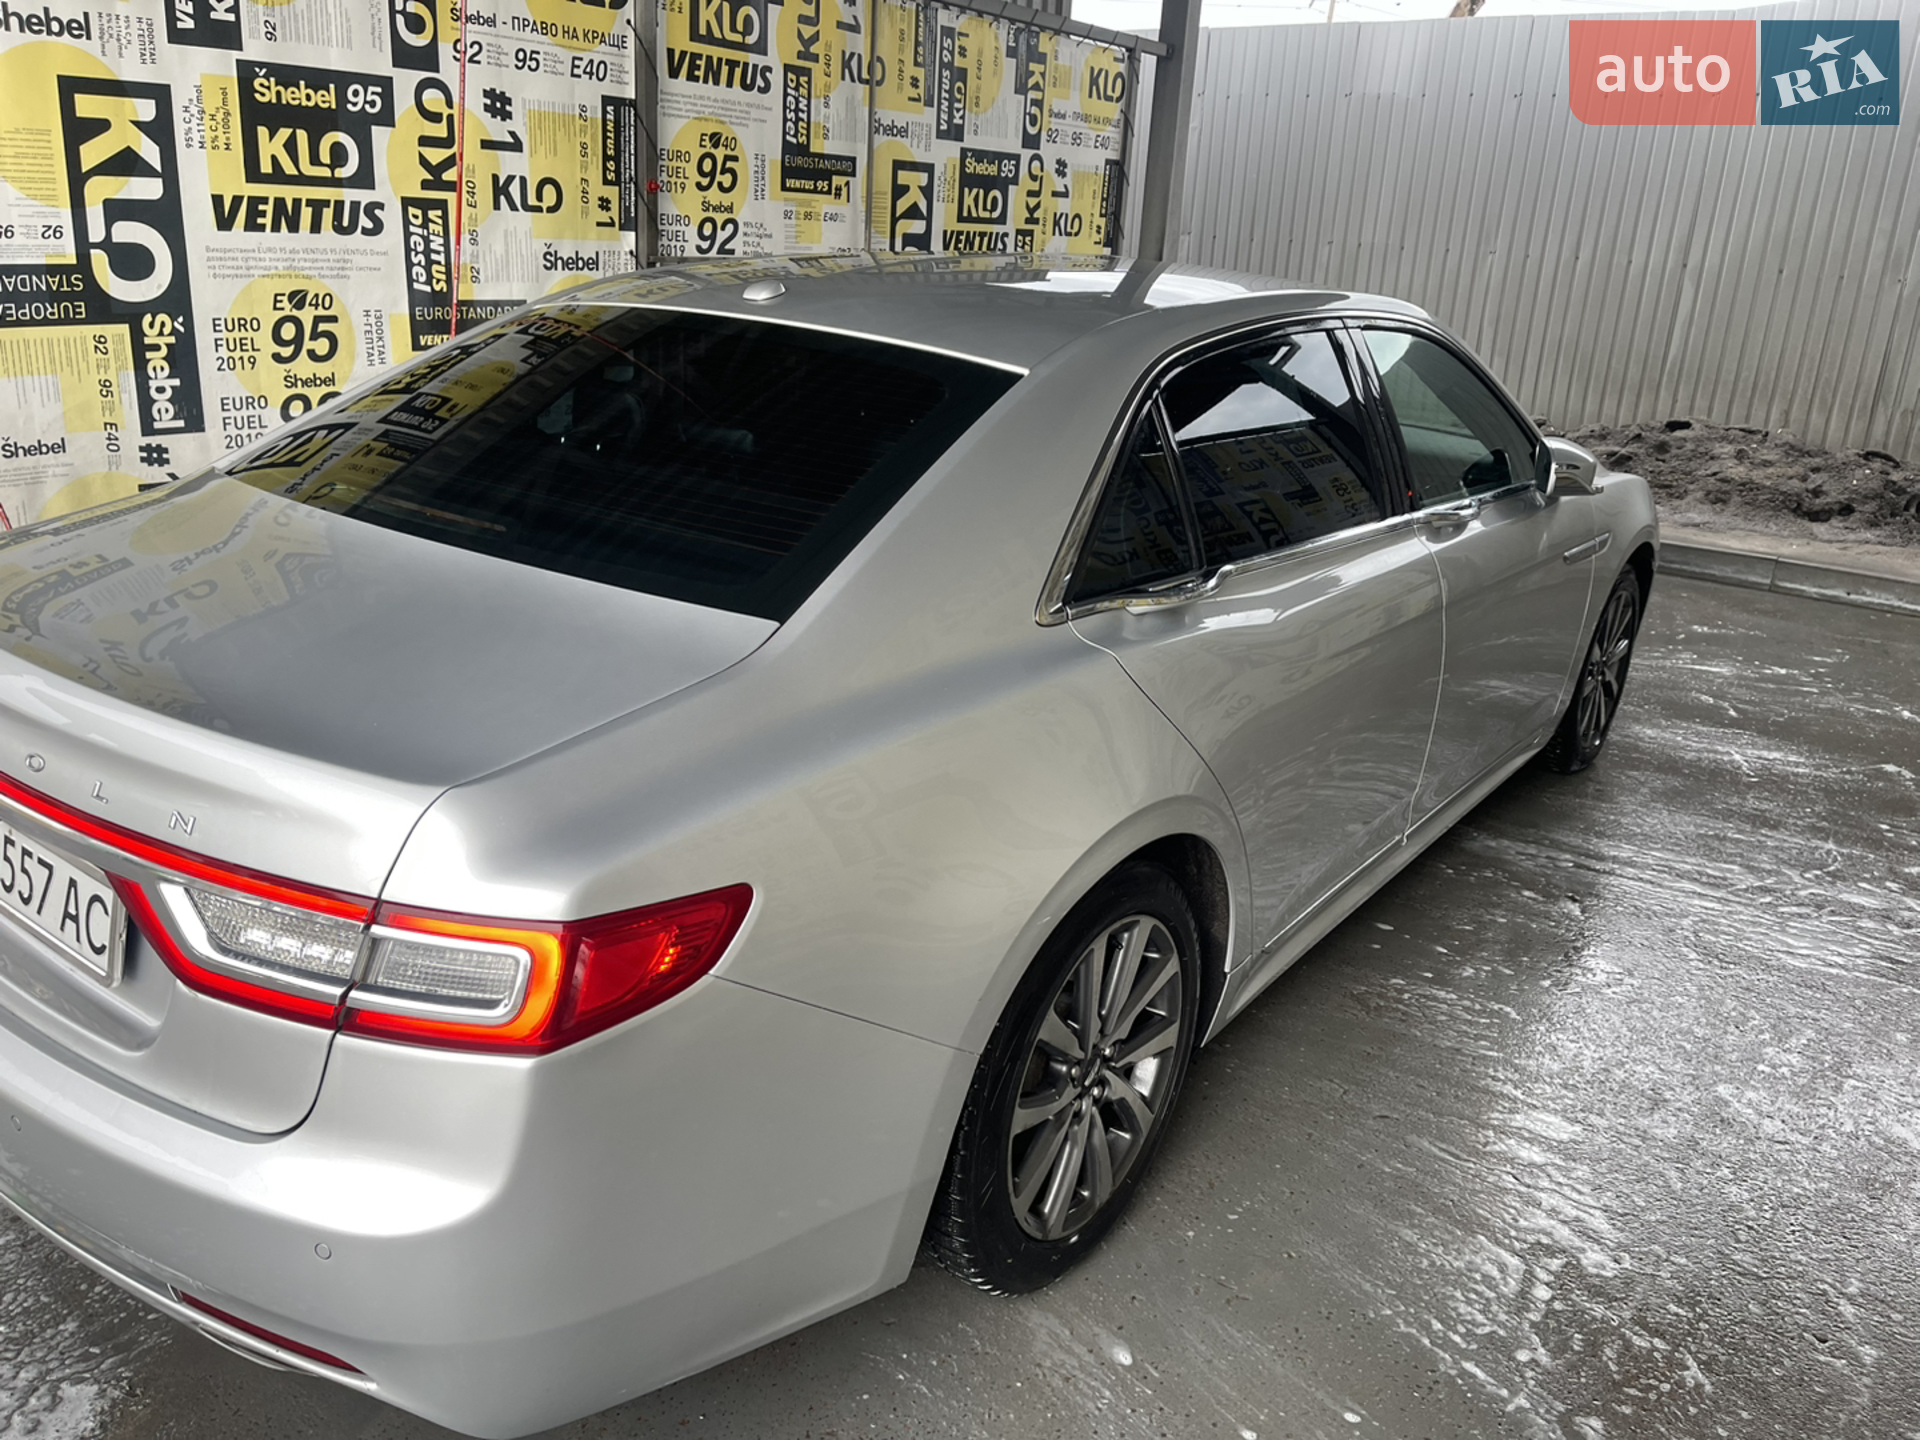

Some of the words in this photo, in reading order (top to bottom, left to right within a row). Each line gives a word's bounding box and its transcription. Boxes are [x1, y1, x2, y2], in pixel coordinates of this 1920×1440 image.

[0, 1, 92, 41] hebel
[264, 19, 277, 42] 92
[511, 15, 558, 38] ПРАВО
[561, 24, 580, 42] НА
[582, 28, 628, 51] КРАЩЕ
[917, 46, 924, 64] 95
[942, 36, 953, 63] 95
[514, 47, 541, 72] 95
[570, 56, 608, 82] E40
[666, 47, 773, 95] VENTUS
[824, 54, 832, 78] E40
[253, 67, 337, 109] Šhebel
[346, 84, 382, 114] 95
[823, 94, 831, 109] 95
[940, 68, 950, 130] VENTUS
[577, 103, 589, 123] 92
[786, 71, 797, 144] Diesel
[798, 76, 808, 145] VENTUS
[606, 105, 615, 157] VENTUS
[823, 125, 830, 141] 92
[1046, 128, 1059, 144] 92
[1071, 132, 1083, 147] 95
[1094, 134, 1110, 150] E40
[257, 125, 360, 178] KLO
[579, 141, 589, 160] 95
[659, 148, 691, 164] EURO
[606, 160, 615, 182] 95
[659, 166, 689, 180] FUEL
[695, 151, 739, 194] 95
[785, 155, 853, 172] EUROSTANDARD
[965, 151, 998, 176] Šhebel
[1000, 159, 1016, 178] 95
[466, 180, 478, 209] E40
[491, 173, 564, 214] KLO
[579, 177, 590, 205] E40
[659, 179, 686, 194] 2019
[786, 178, 815, 189] VENTUS
[816, 181, 829, 192] 95
[211, 194, 385, 236] VENTUS
[701, 196, 734, 214] Šhebel
[783, 209, 793, 220] 92
[803, 211, 813, 221] 95
[823, 211, 839, 222] E40
[659, 213, 691, 227] EURO
[41, 224, 64, 240] 92
[468, 228, 480, 247] 95
[659, 229, 689, 243] FUEL
[695, 216, 739, 256] 92
[942, 229, 1009, 253] VENTUS
[407, 206, 432, 293] Diesel
[427, 208, 447, 293] VENTUS
[542, 243, 600, 272] Šhebel
[659, 244, 686, 257] 2019
[0, 273, 84, 292] STANDA
[470, 266, 481, 285] 92
[0, 301, 86, 321] EUROPE
[212, 317, 261, 333] EURO
[93, 334, 109, 356] 92
[214, 337, 261, 353] FUEL
[271, 315, 339, 364] 95
[141, 313, 185, 429] Šhebel
[216, 356, 257, 372] 2019
[98, 378, 114, 398] 95
[283, 369, 336, 389] Šhebel
[220, 395, 268, 412] EURO
[222, 415, 268, 432] FUEL
[1, 436, 66, 459] Šhebel
[103, 421, 121, 453] E40
[1, 834, 54, 916] 557
[59, 876, 110, 956] AC
